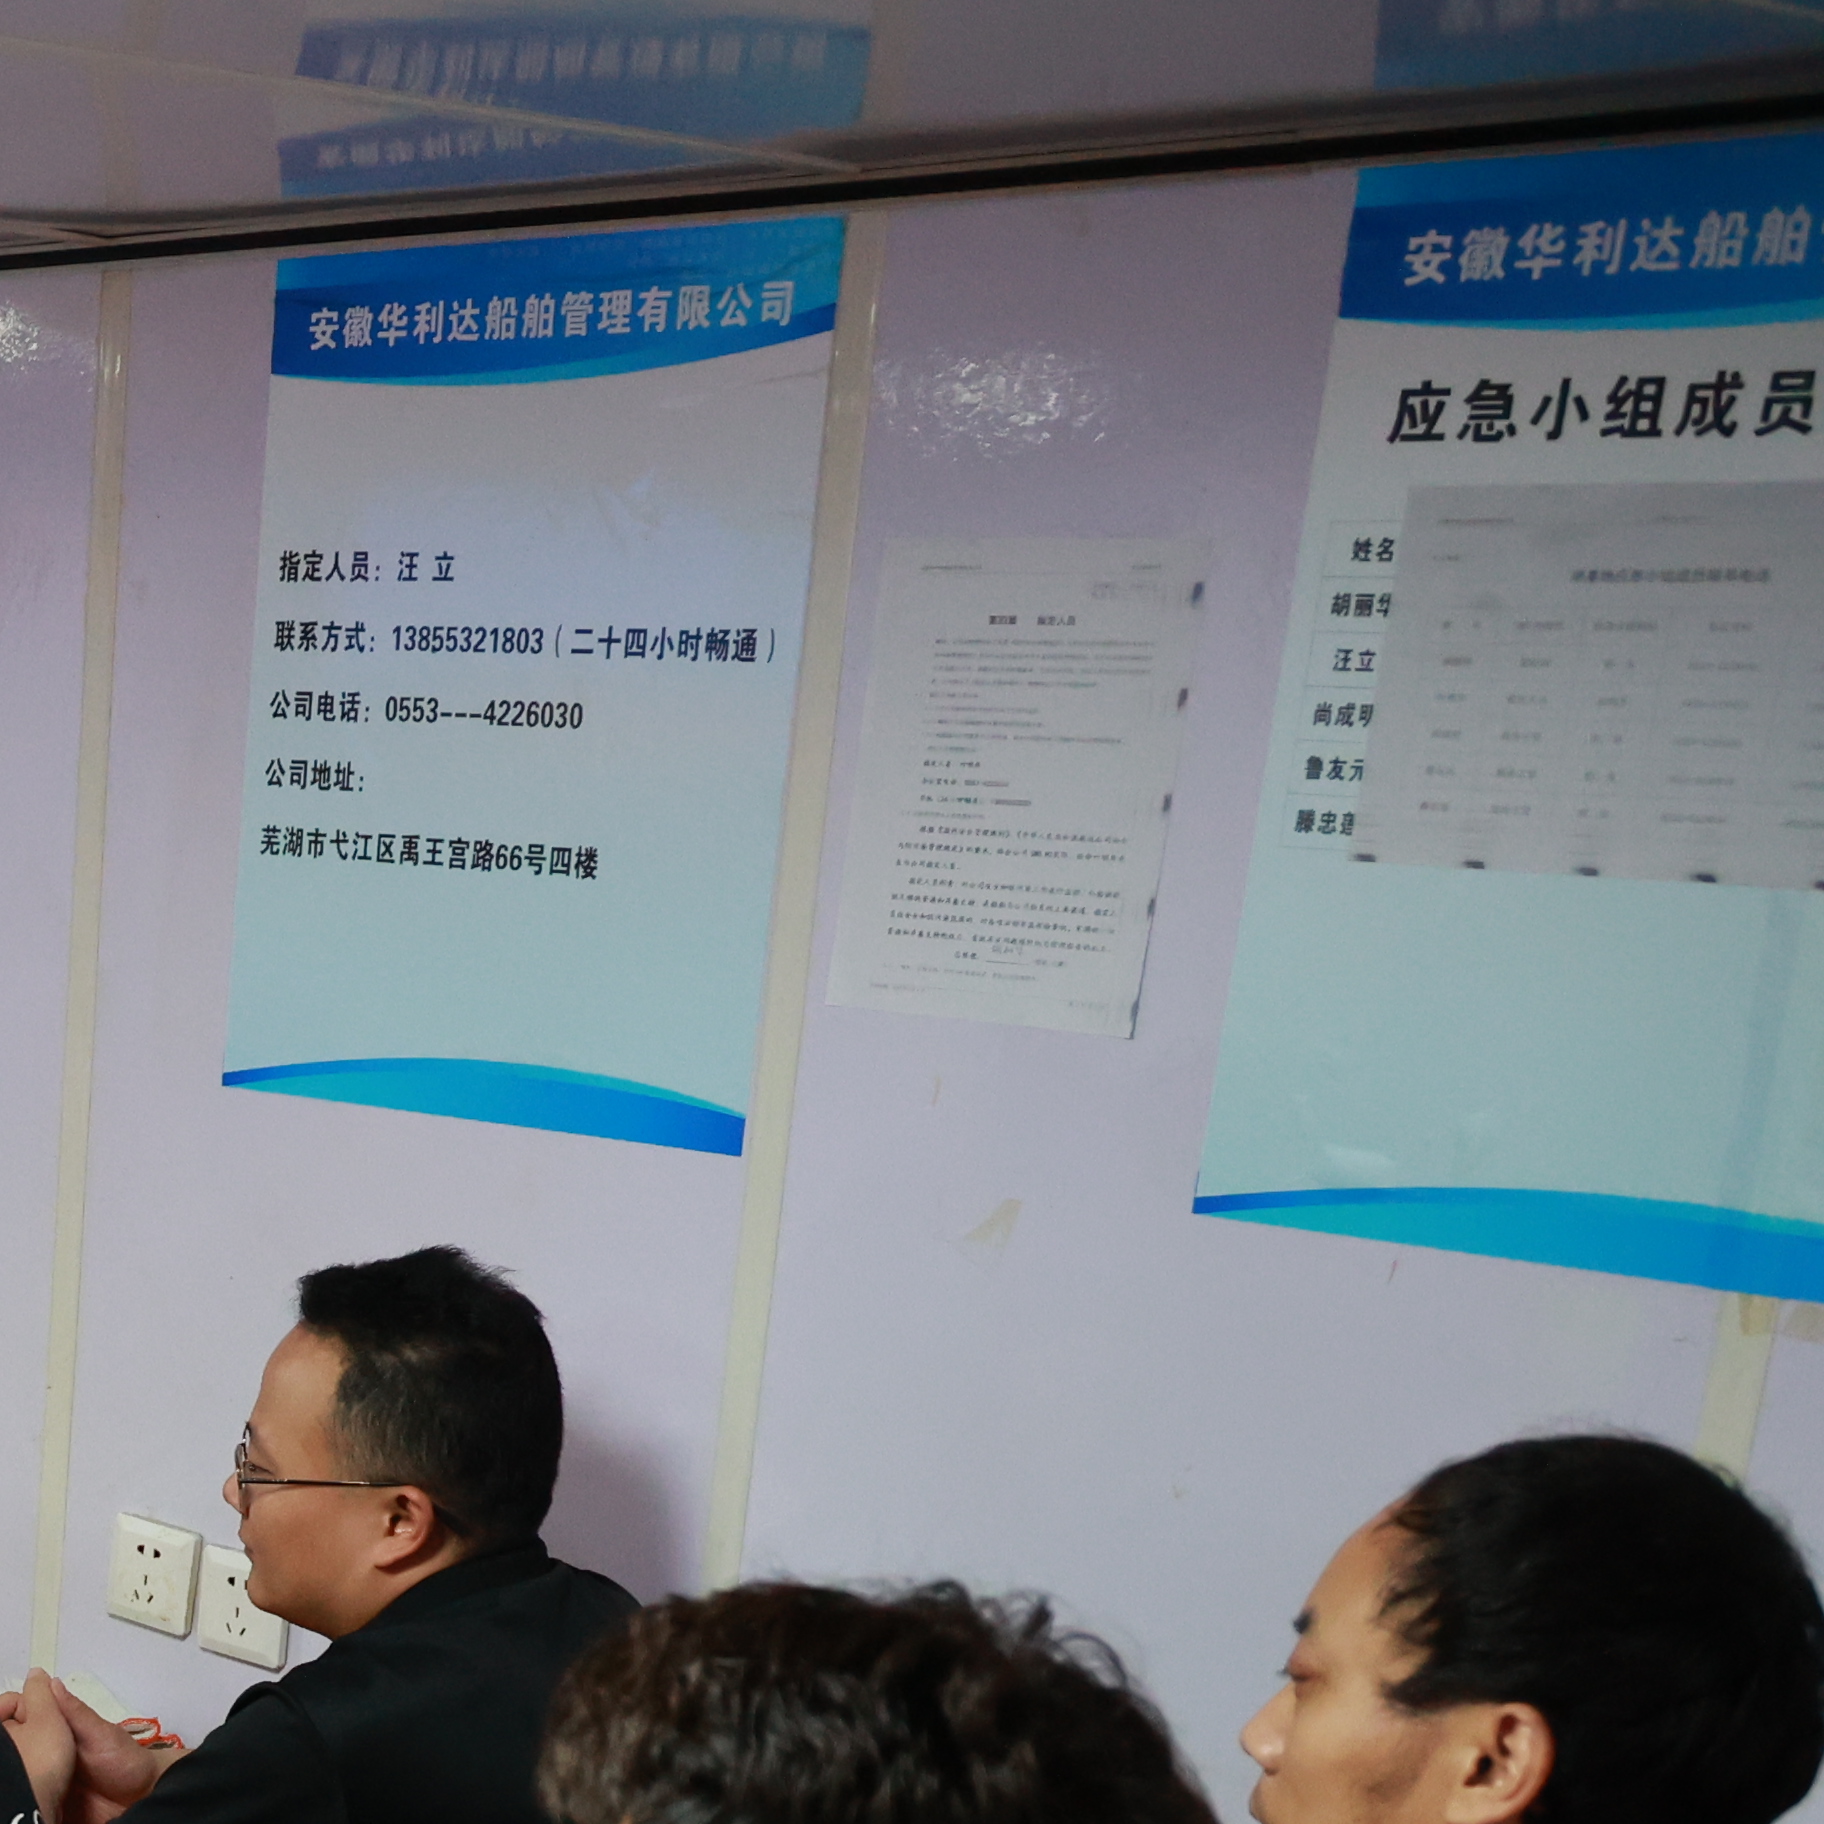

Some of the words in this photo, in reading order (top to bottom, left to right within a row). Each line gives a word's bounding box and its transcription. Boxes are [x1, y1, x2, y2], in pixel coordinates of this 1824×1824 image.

[1403, 203, 1824, 287] 安徽华利达船舶
[309, 280, 796, 351] 安徽华利达船舶管理有限公司
[1387, 369, 1817, 444] 应急小组成员
[1351, 537, 1395, 562] 姓名
[1333, 648, 1377, 672] 汪立
[265, 758, 365, 792] 公司地址：
[259, 823, 599, 881] 芜湖市弋江区禹王宫路66号四楼
